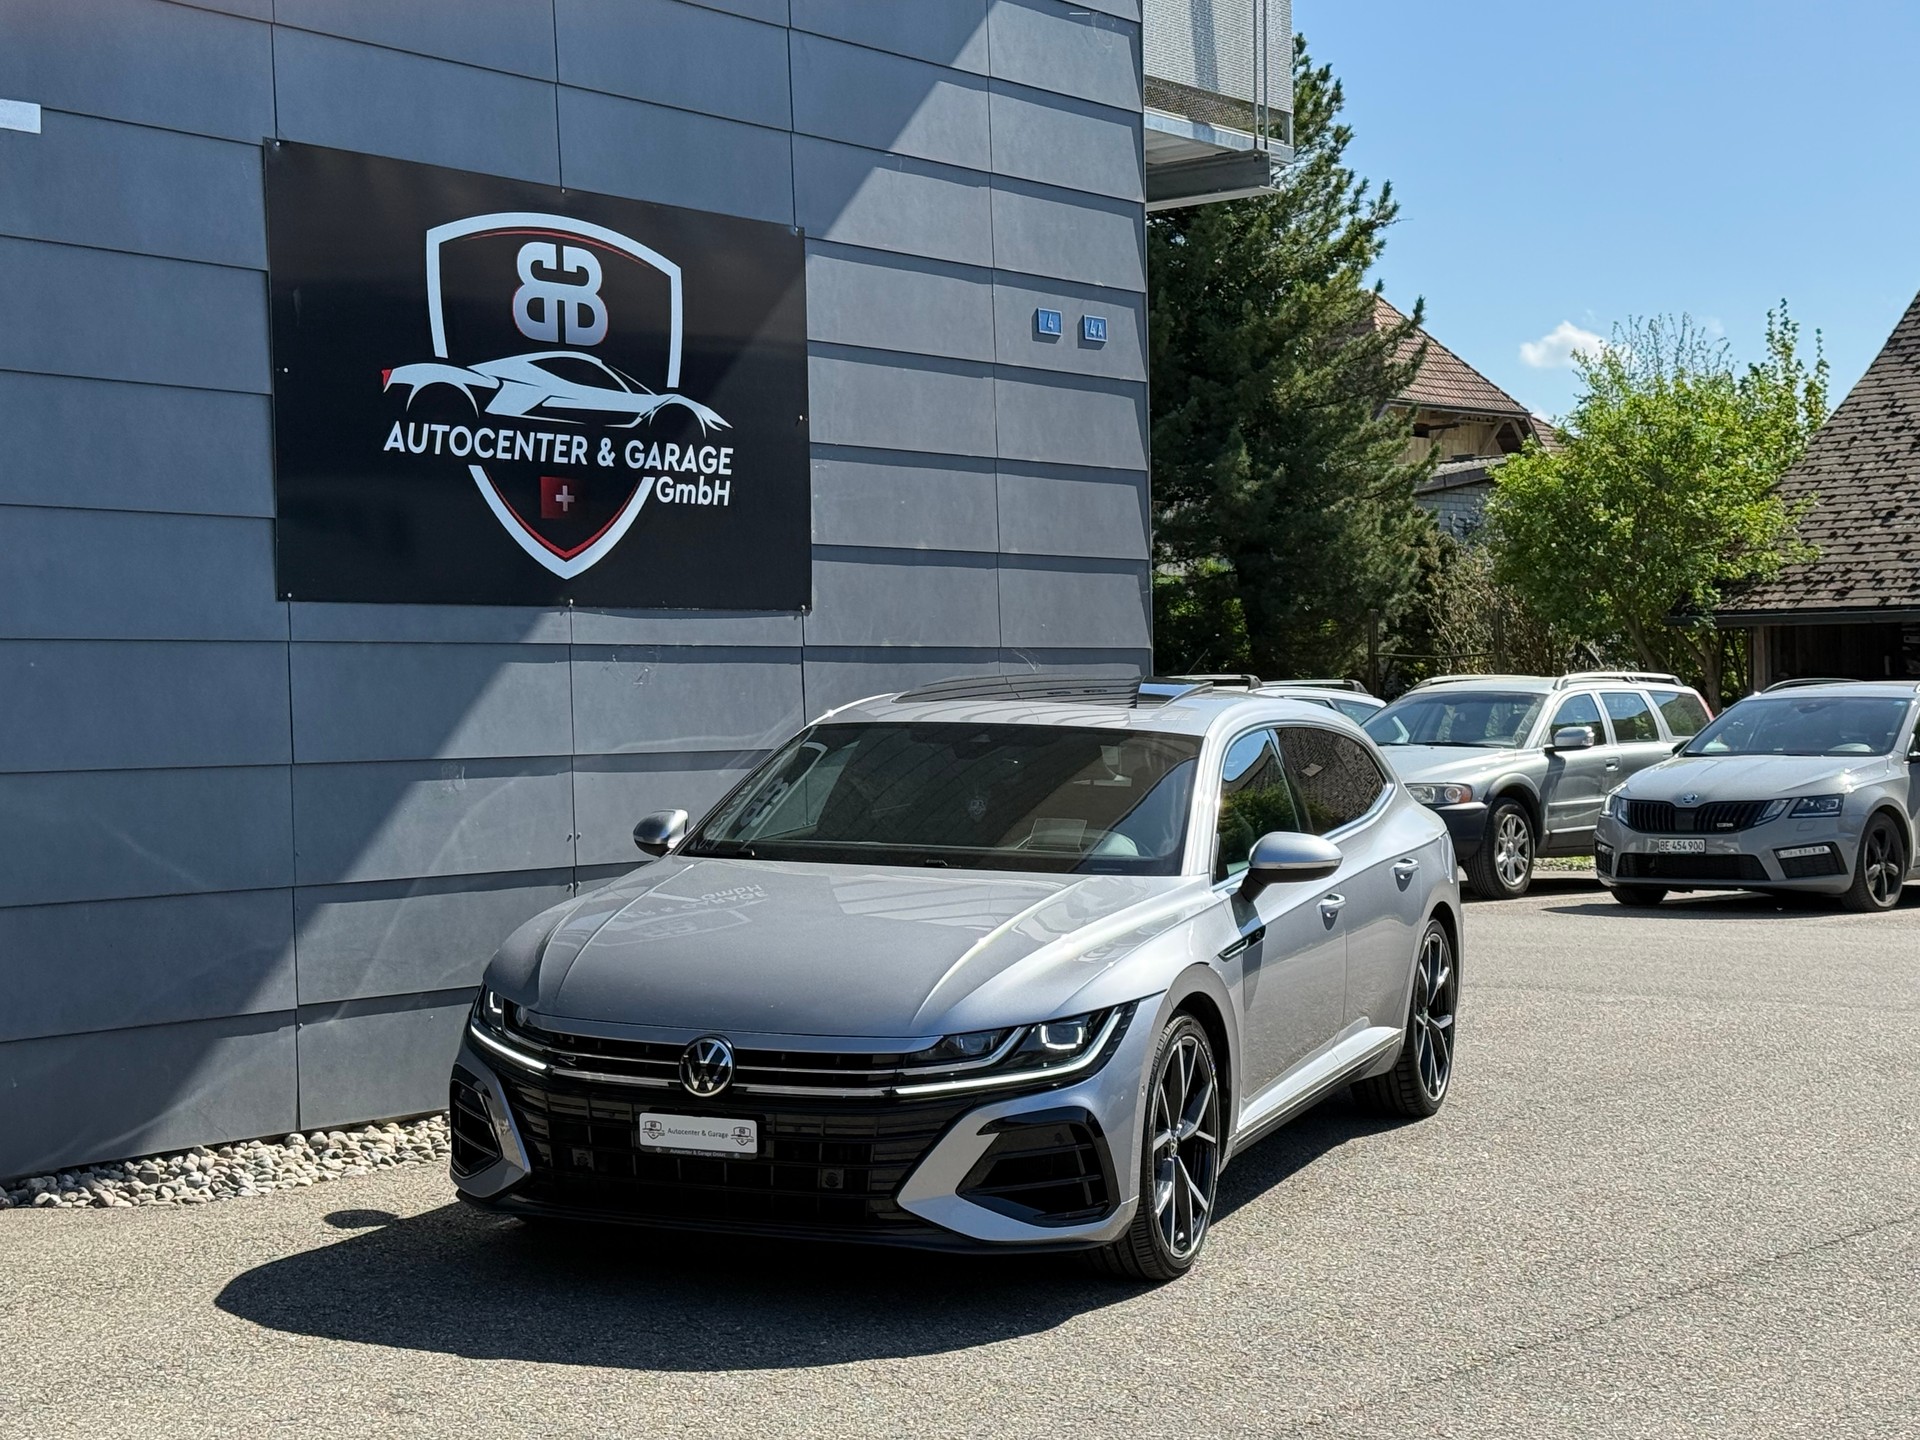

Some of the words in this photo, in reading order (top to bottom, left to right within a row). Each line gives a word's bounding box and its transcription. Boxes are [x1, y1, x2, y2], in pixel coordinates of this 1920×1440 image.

[1047, 313, 1054, 331] 4
[1089, 320, 1104, 338] 4A
[383, 420, 588, 466] AUTOCENTER
[596, 438, 616, 468] &
[624, 440, 734, 475] GARAGE
[655, 476, 731, 507] GmbH
[667, 1127, 700, 1137] Autocenter
[708, 1131, 729, 1139] Garage
